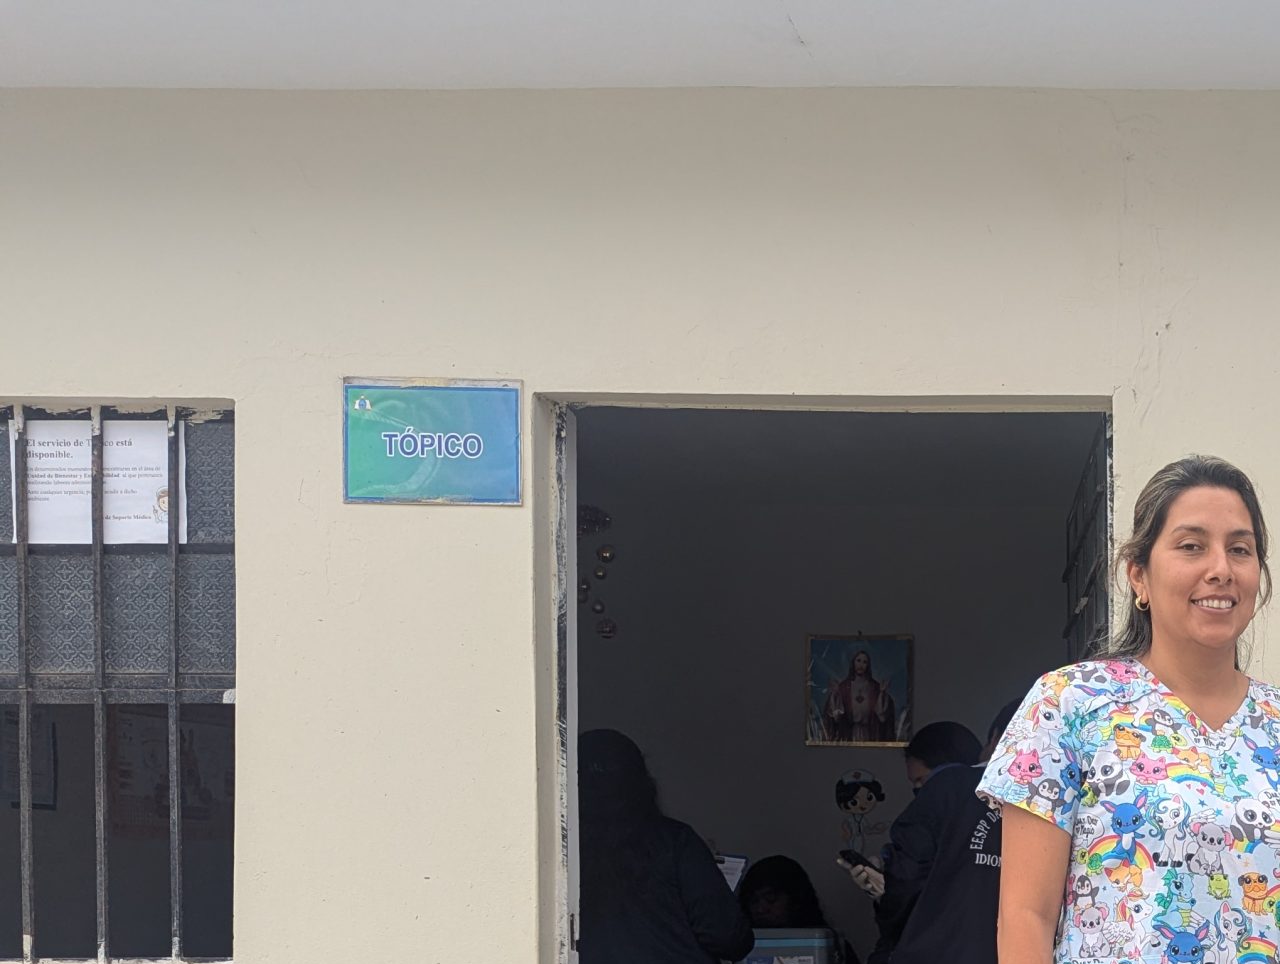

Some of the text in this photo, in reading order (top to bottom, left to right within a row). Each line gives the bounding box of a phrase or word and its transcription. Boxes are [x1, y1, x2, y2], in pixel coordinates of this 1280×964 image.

[38, 439, 72, 447] servicio
[73, 439, 84, 447] de
[86, 439, 114, 447] Tco
[115, 439, 133, 447] está
[382, 427, 483, 458] TÓPICO
[26, 450, 74, 460] disponible.
[970, 819, 991, 850] EESPP
